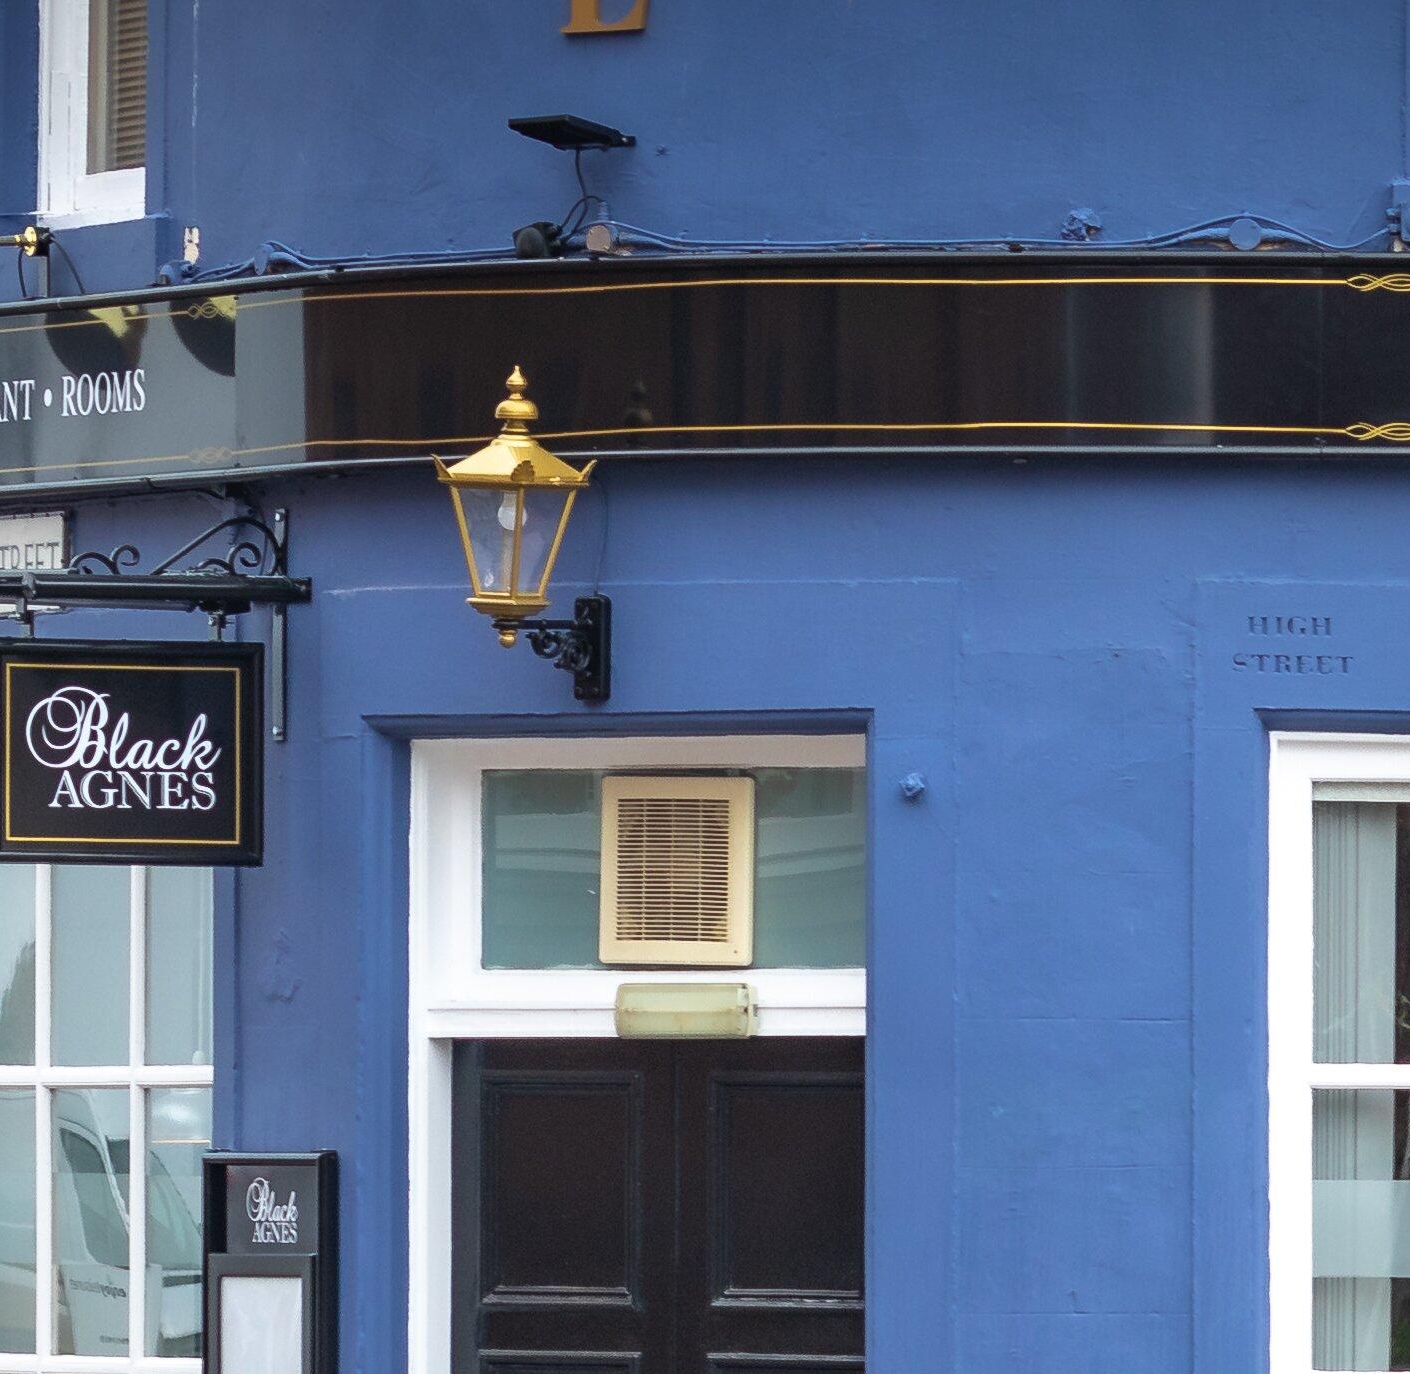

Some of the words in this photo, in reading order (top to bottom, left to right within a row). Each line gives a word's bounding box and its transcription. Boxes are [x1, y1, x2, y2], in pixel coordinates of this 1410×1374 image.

[60, 368, 146, 417] ROOMS
[1247, 616, 1332, 636] HIGH
[1233, 653, 1354, 674] STREET
[25, 686, 222, 771] Black
[47, 769, 216, 811] AGNES
[246, 1177, 299, 1222] Black
[252, 1221, 299, 1244] AGNES
